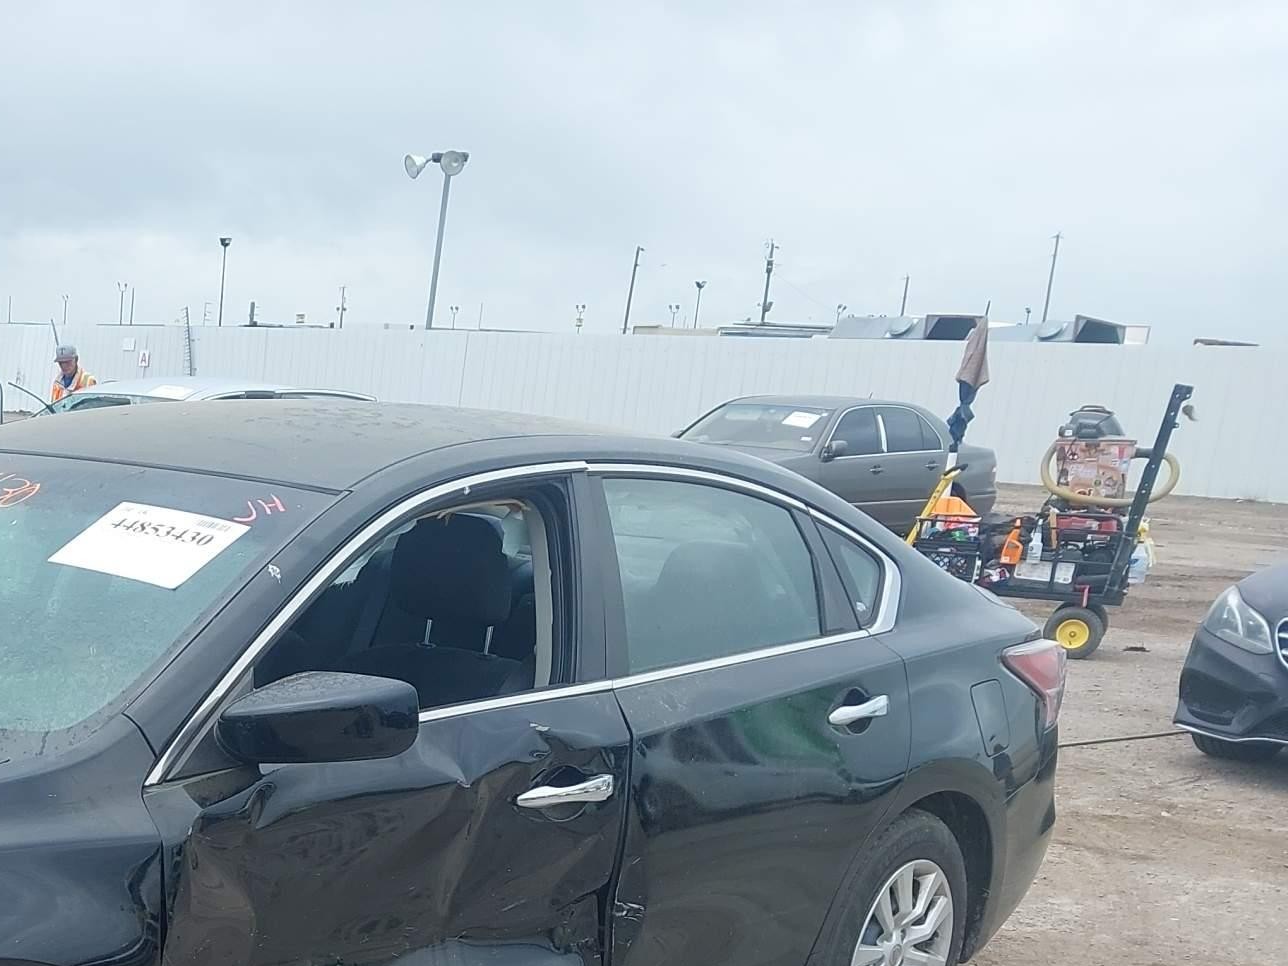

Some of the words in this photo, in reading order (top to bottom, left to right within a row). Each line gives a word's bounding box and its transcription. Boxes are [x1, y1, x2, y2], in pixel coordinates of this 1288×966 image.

[140, 352, 147, 364] A
[233, 493, 286, 522] JH
[111, 517, 215, 546] 44853430
